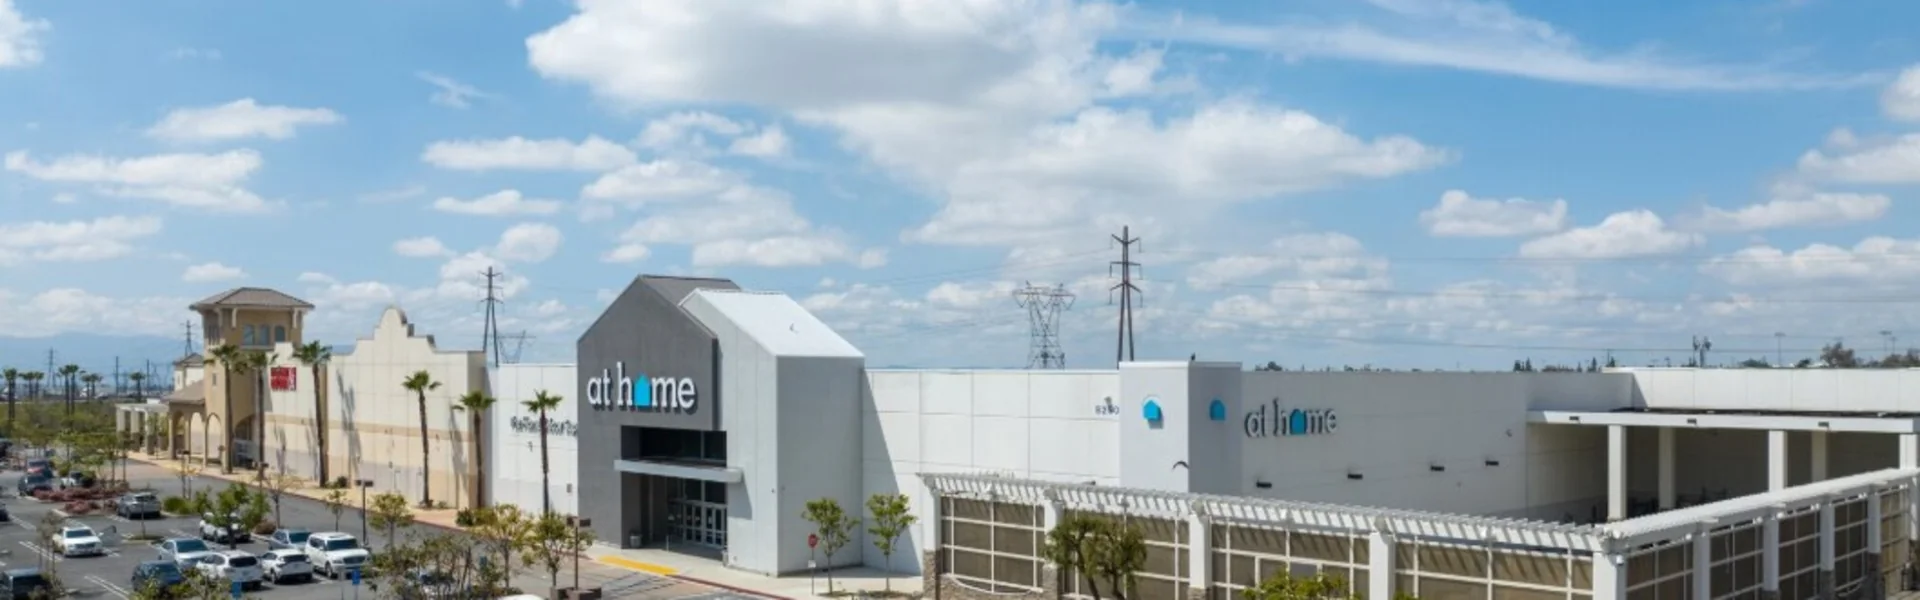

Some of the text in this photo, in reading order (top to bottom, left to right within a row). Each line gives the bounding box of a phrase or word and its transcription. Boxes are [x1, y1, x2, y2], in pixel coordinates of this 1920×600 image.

[587, 361, 697, 410] at home
[1244, 397, 1337, 438] at home
